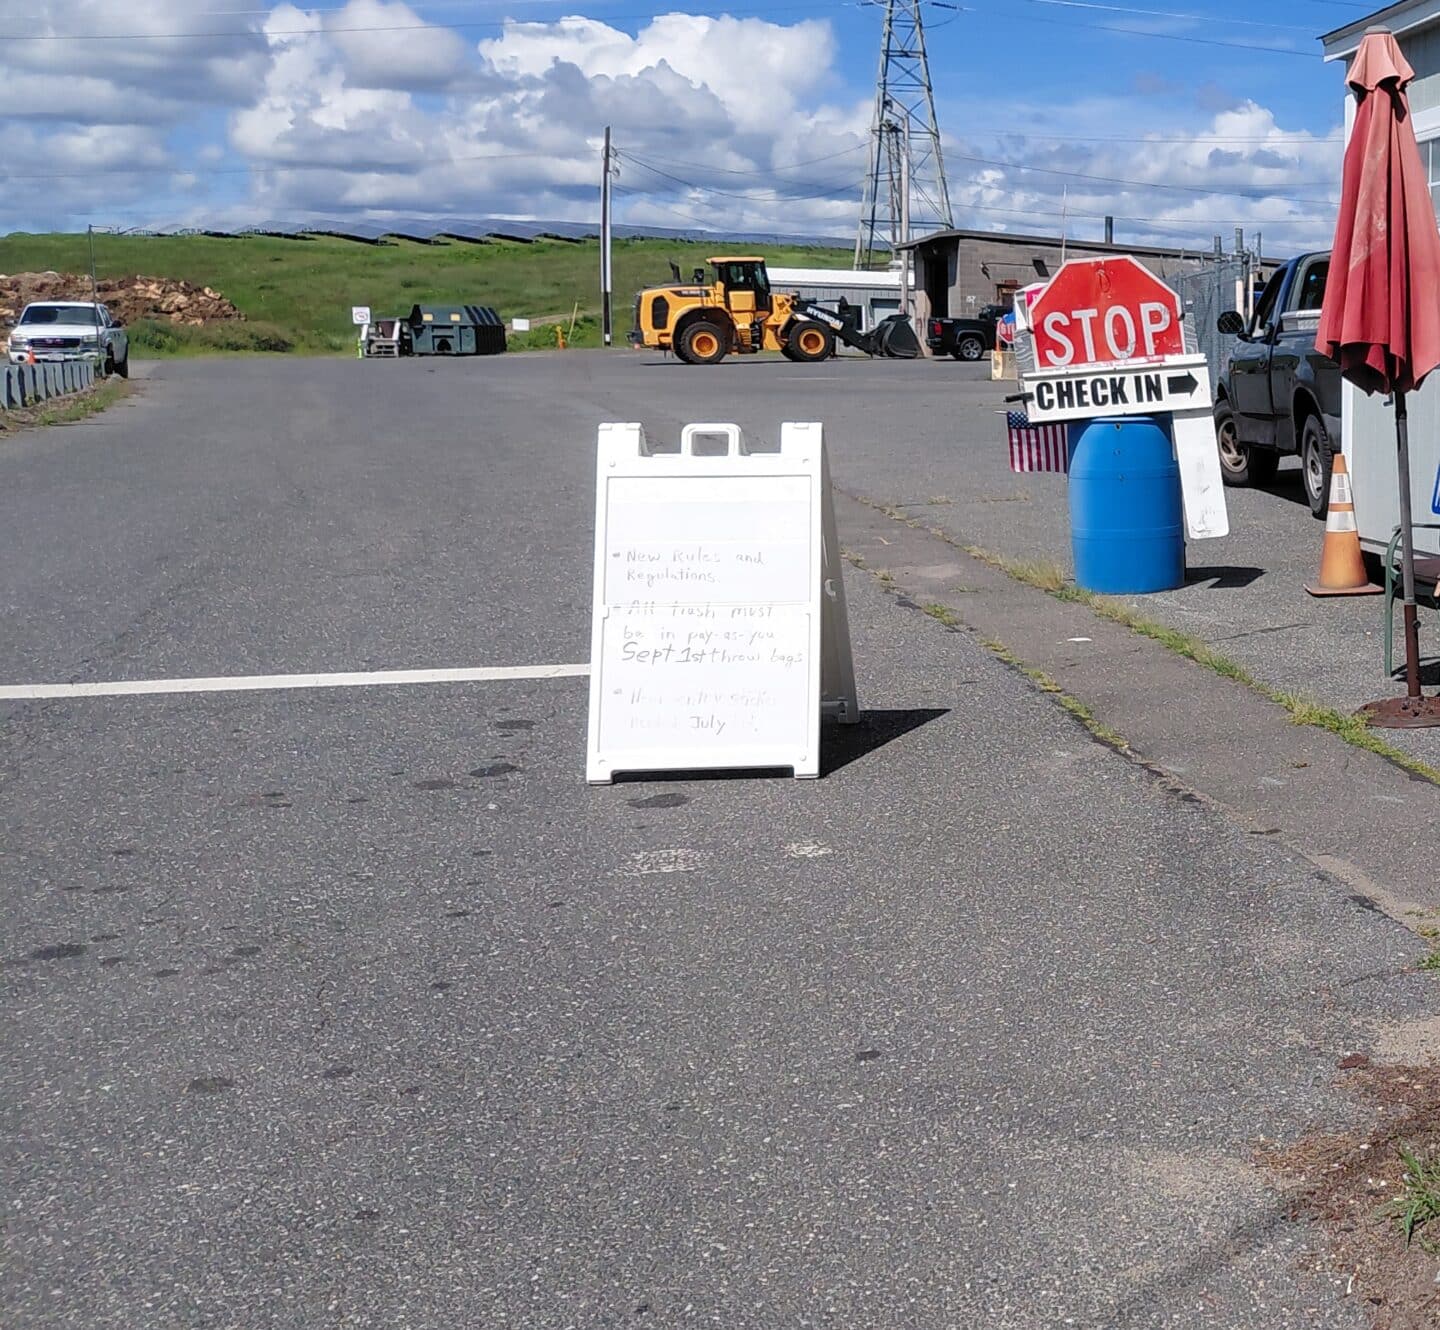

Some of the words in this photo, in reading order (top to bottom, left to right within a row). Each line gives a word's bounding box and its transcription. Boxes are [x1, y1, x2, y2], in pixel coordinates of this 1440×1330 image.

[1043, 301, 1171, 367] STOP
[1035, 375, 1130, 411] CHECK
[1136, 373, 1163, 403] IN
[626, 551, 661, 562] New
[672, 547, 721, 563] Rules
[736, 552, 767, 565] and
[622, 642, 676, 665] Sept
[675, 647, 708, 663] 1st
[690, 715, 726, 735] July
